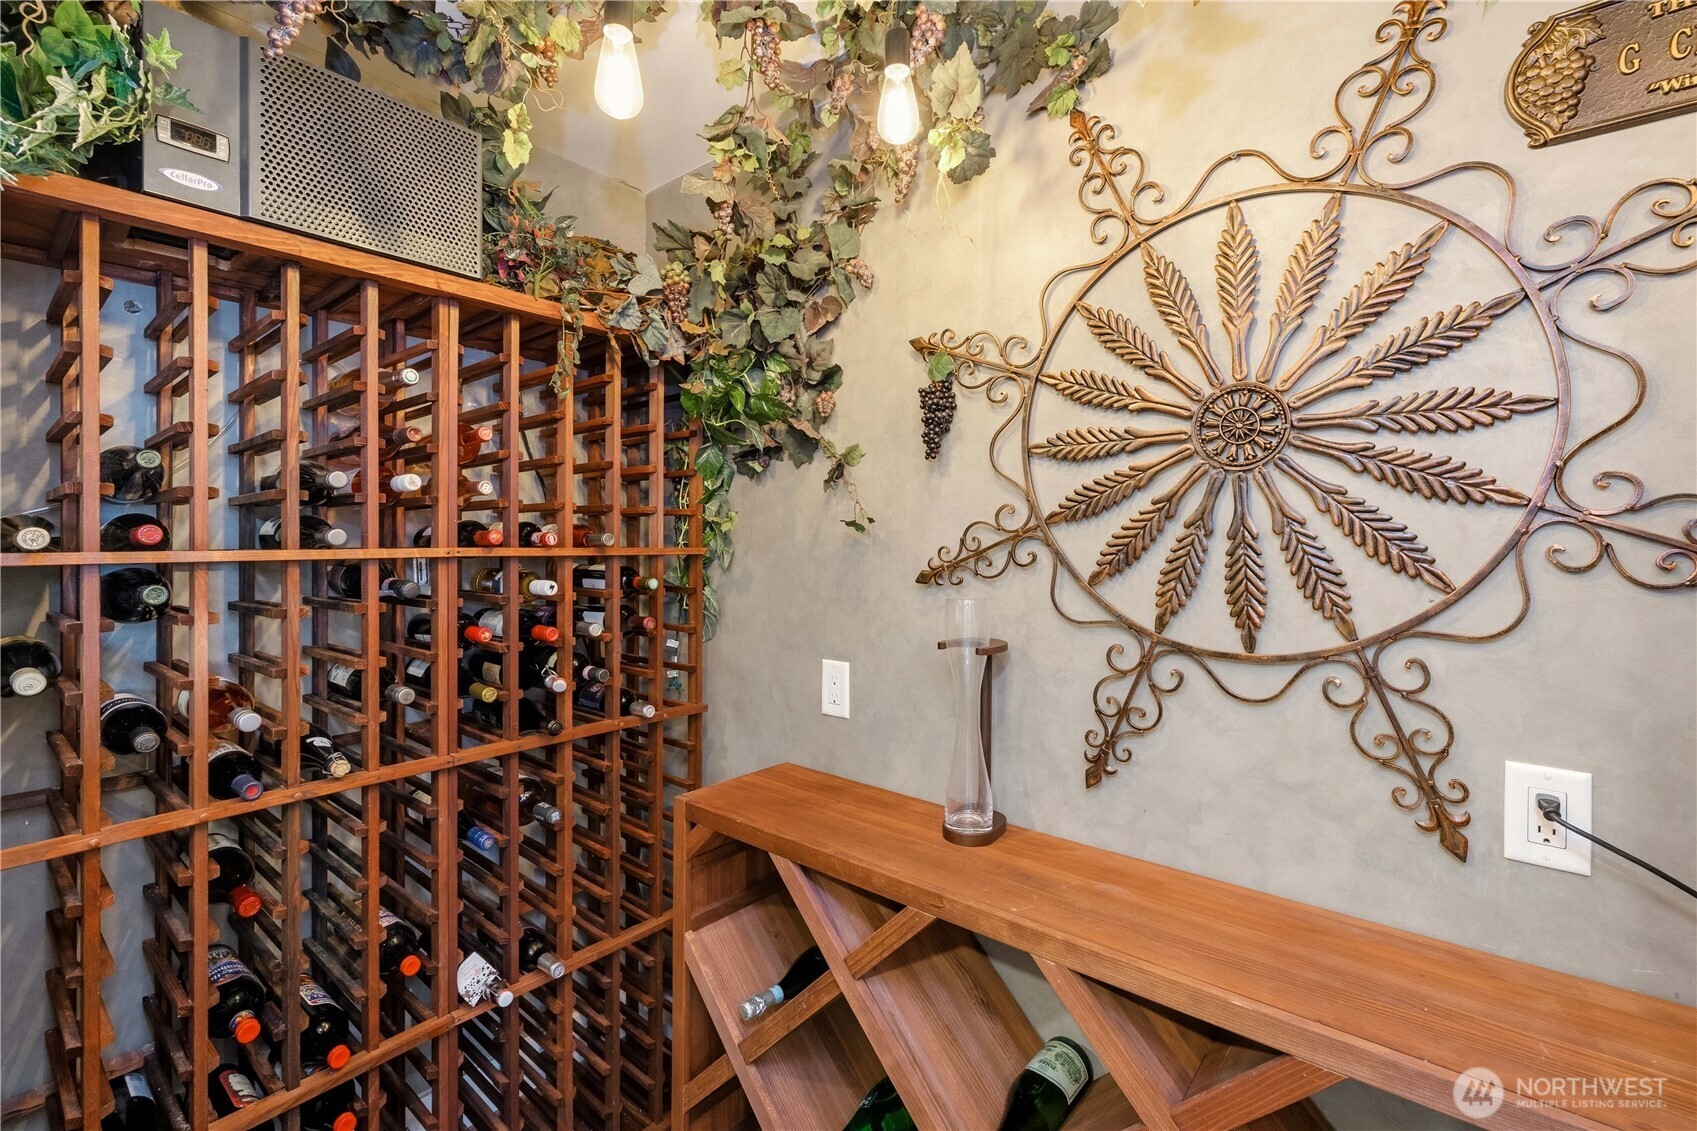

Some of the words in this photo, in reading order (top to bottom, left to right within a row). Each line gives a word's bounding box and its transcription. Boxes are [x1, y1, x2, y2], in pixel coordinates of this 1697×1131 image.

[1618, 42, 1642, 75] G
[1670, 27, 1697, 60] C
[170, 171, 213, 189] CellarPro
